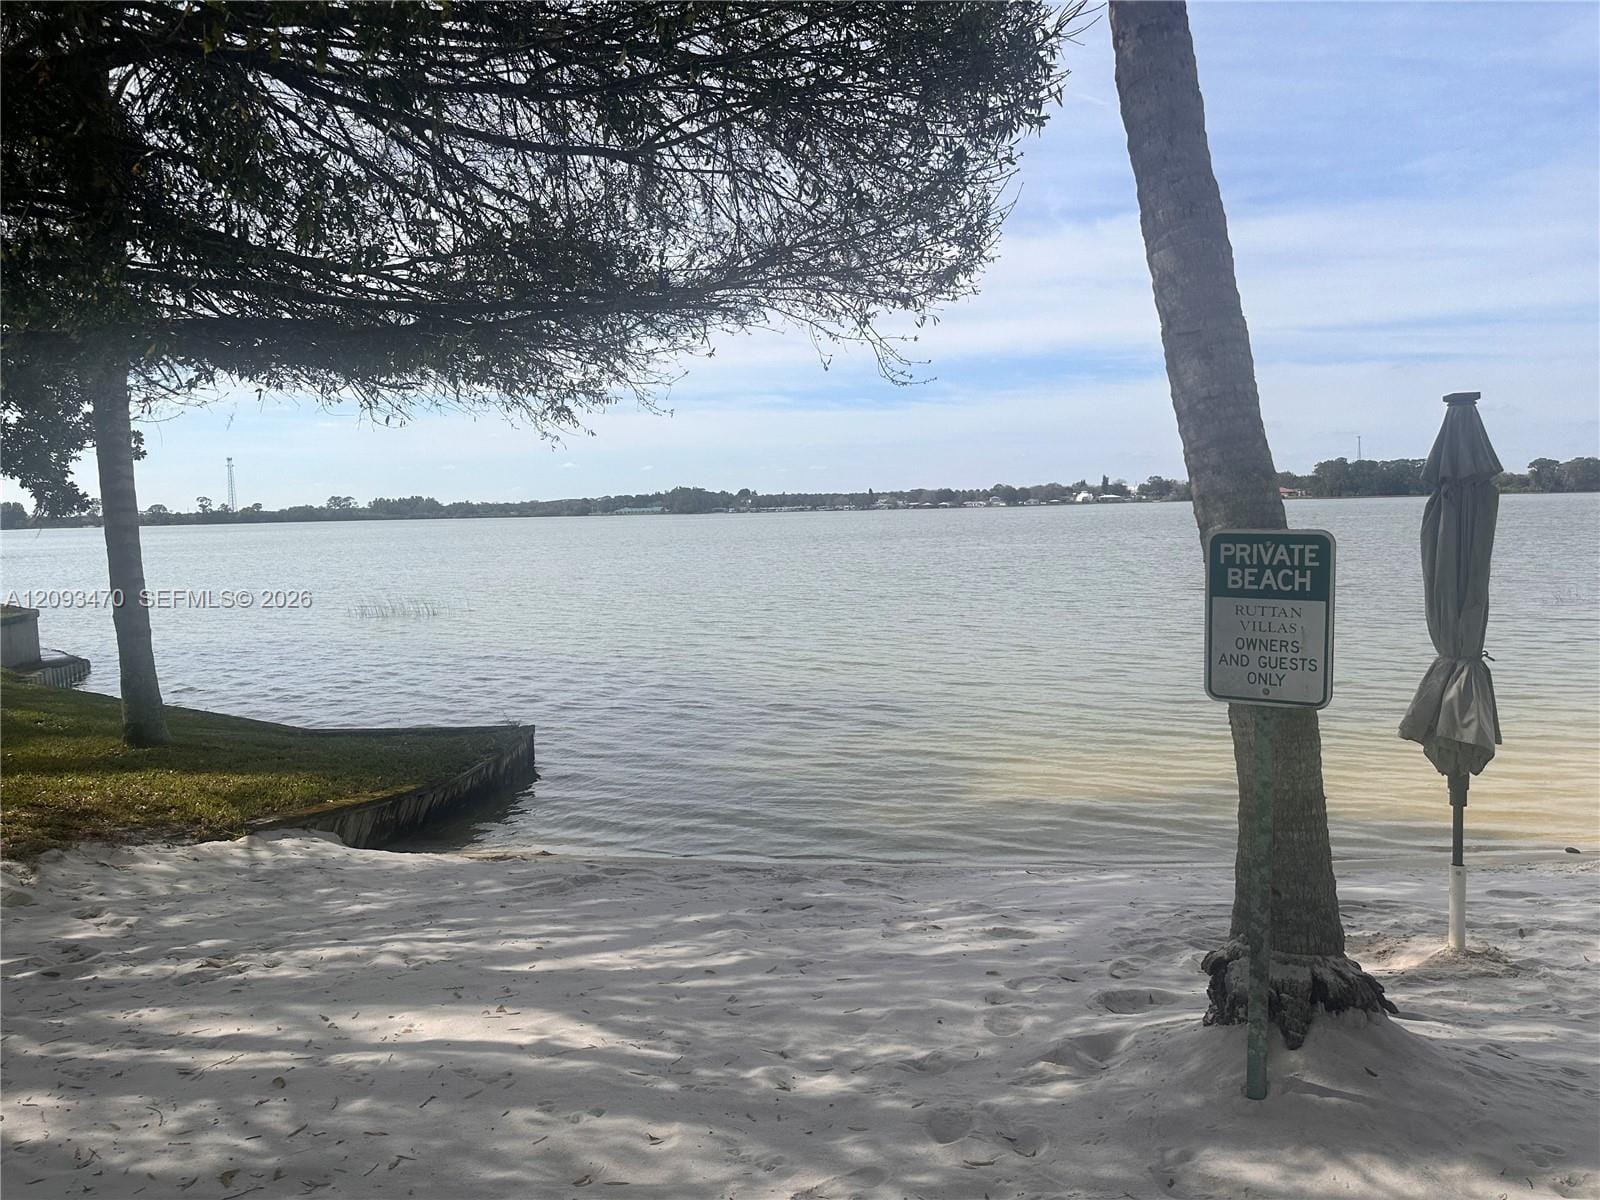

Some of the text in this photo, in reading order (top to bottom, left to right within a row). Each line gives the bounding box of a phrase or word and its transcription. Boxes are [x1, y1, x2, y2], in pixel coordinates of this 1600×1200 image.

[1220, 543, 1320, 566] PRIVATE
[1227, 568, 1310, 591] BEACH
[1235, 605, 1302, 618] RUTTAN
[1240, 620, 1297, 633] VILLAS
[1235, 637, 1300, 653] OWNERS
[1219, 653, 1318, 672] AND GUESTS
[1247, 672, 1286, 687] ONLY
